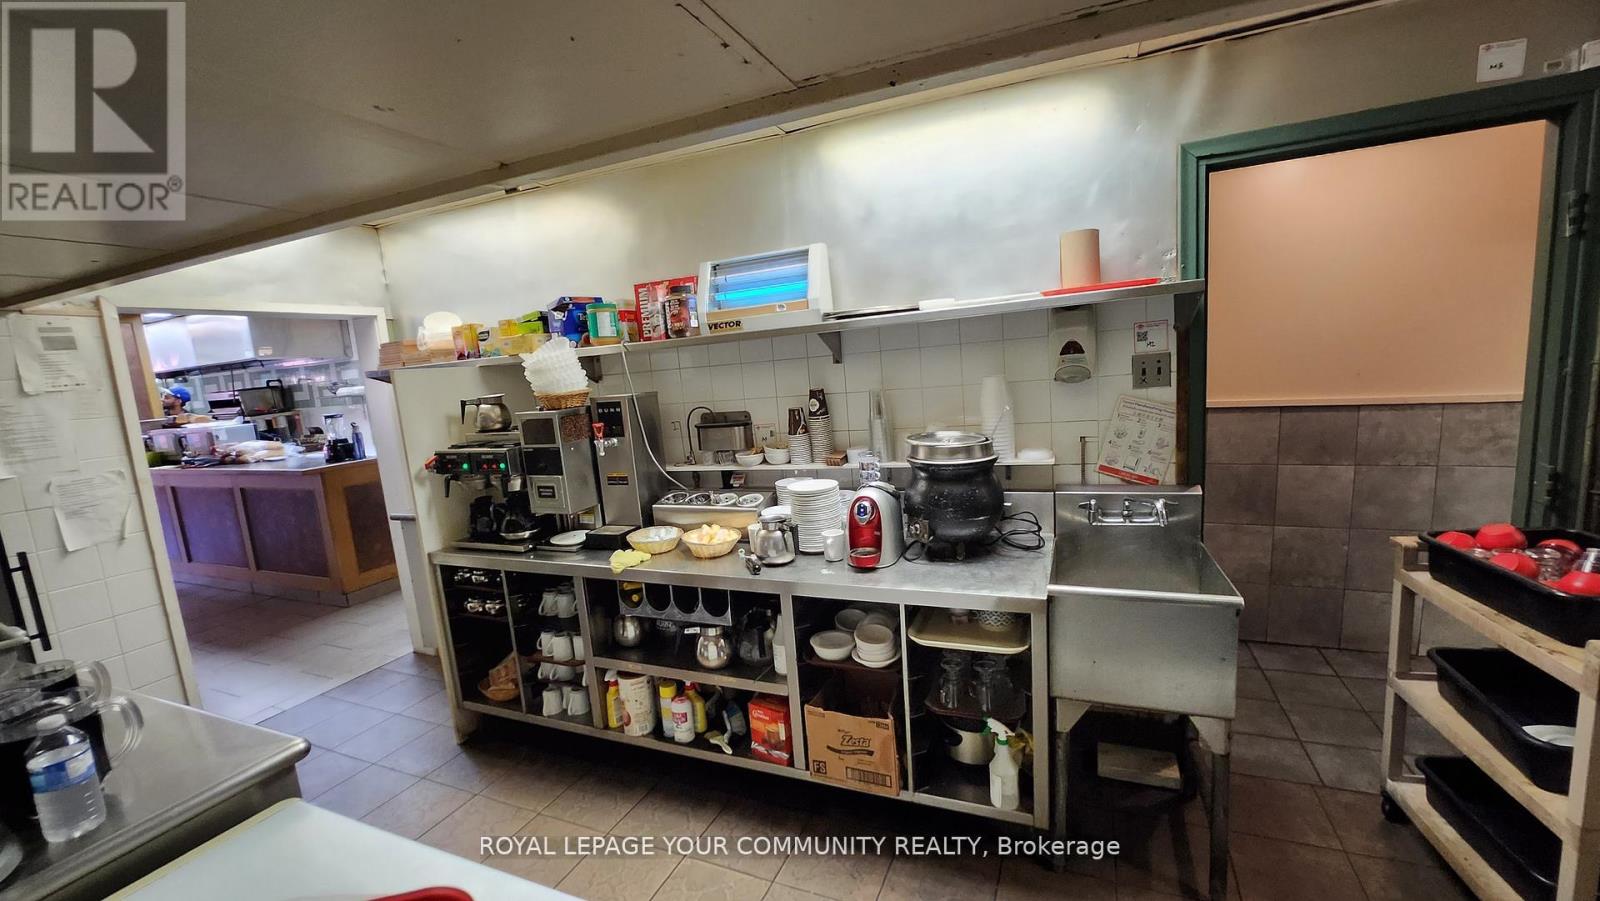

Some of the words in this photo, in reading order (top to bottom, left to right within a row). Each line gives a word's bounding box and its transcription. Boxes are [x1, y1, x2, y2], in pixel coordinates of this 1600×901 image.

[639, 287, 652, 338] PREMIUM
[708, 320, 741, 331] VECTOR
[841, 734, 872, 749] Zesta
[813, 761, 826, 774] FS
